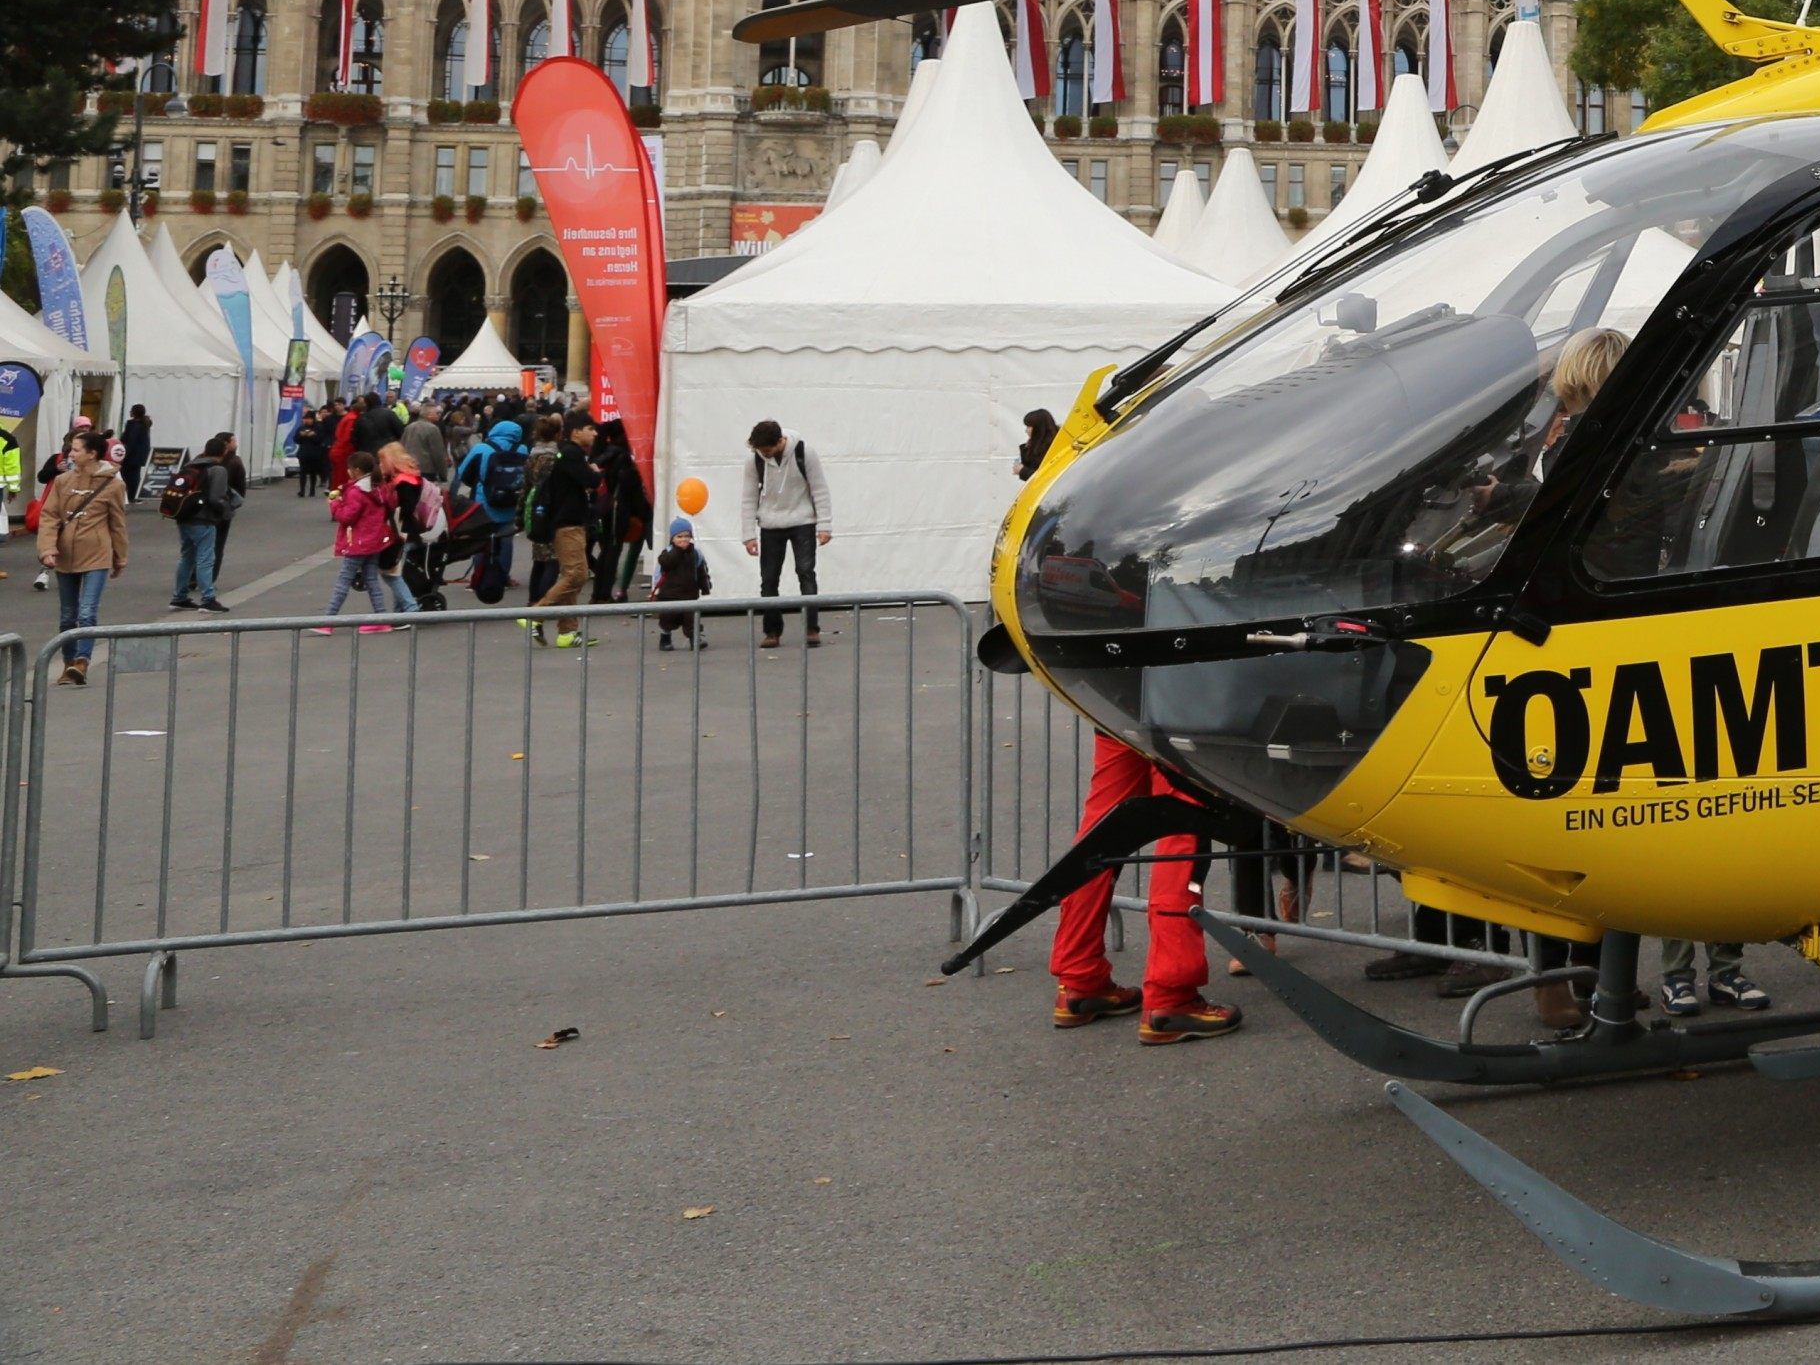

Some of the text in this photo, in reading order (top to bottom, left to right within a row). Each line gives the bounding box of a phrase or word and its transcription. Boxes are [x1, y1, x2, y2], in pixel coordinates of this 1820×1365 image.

[1565, 808, 1605, 832] EIN
[1611, 799, 1690, 828] GUTES
[1696, 785, 1787, 819] GEFÜHL
